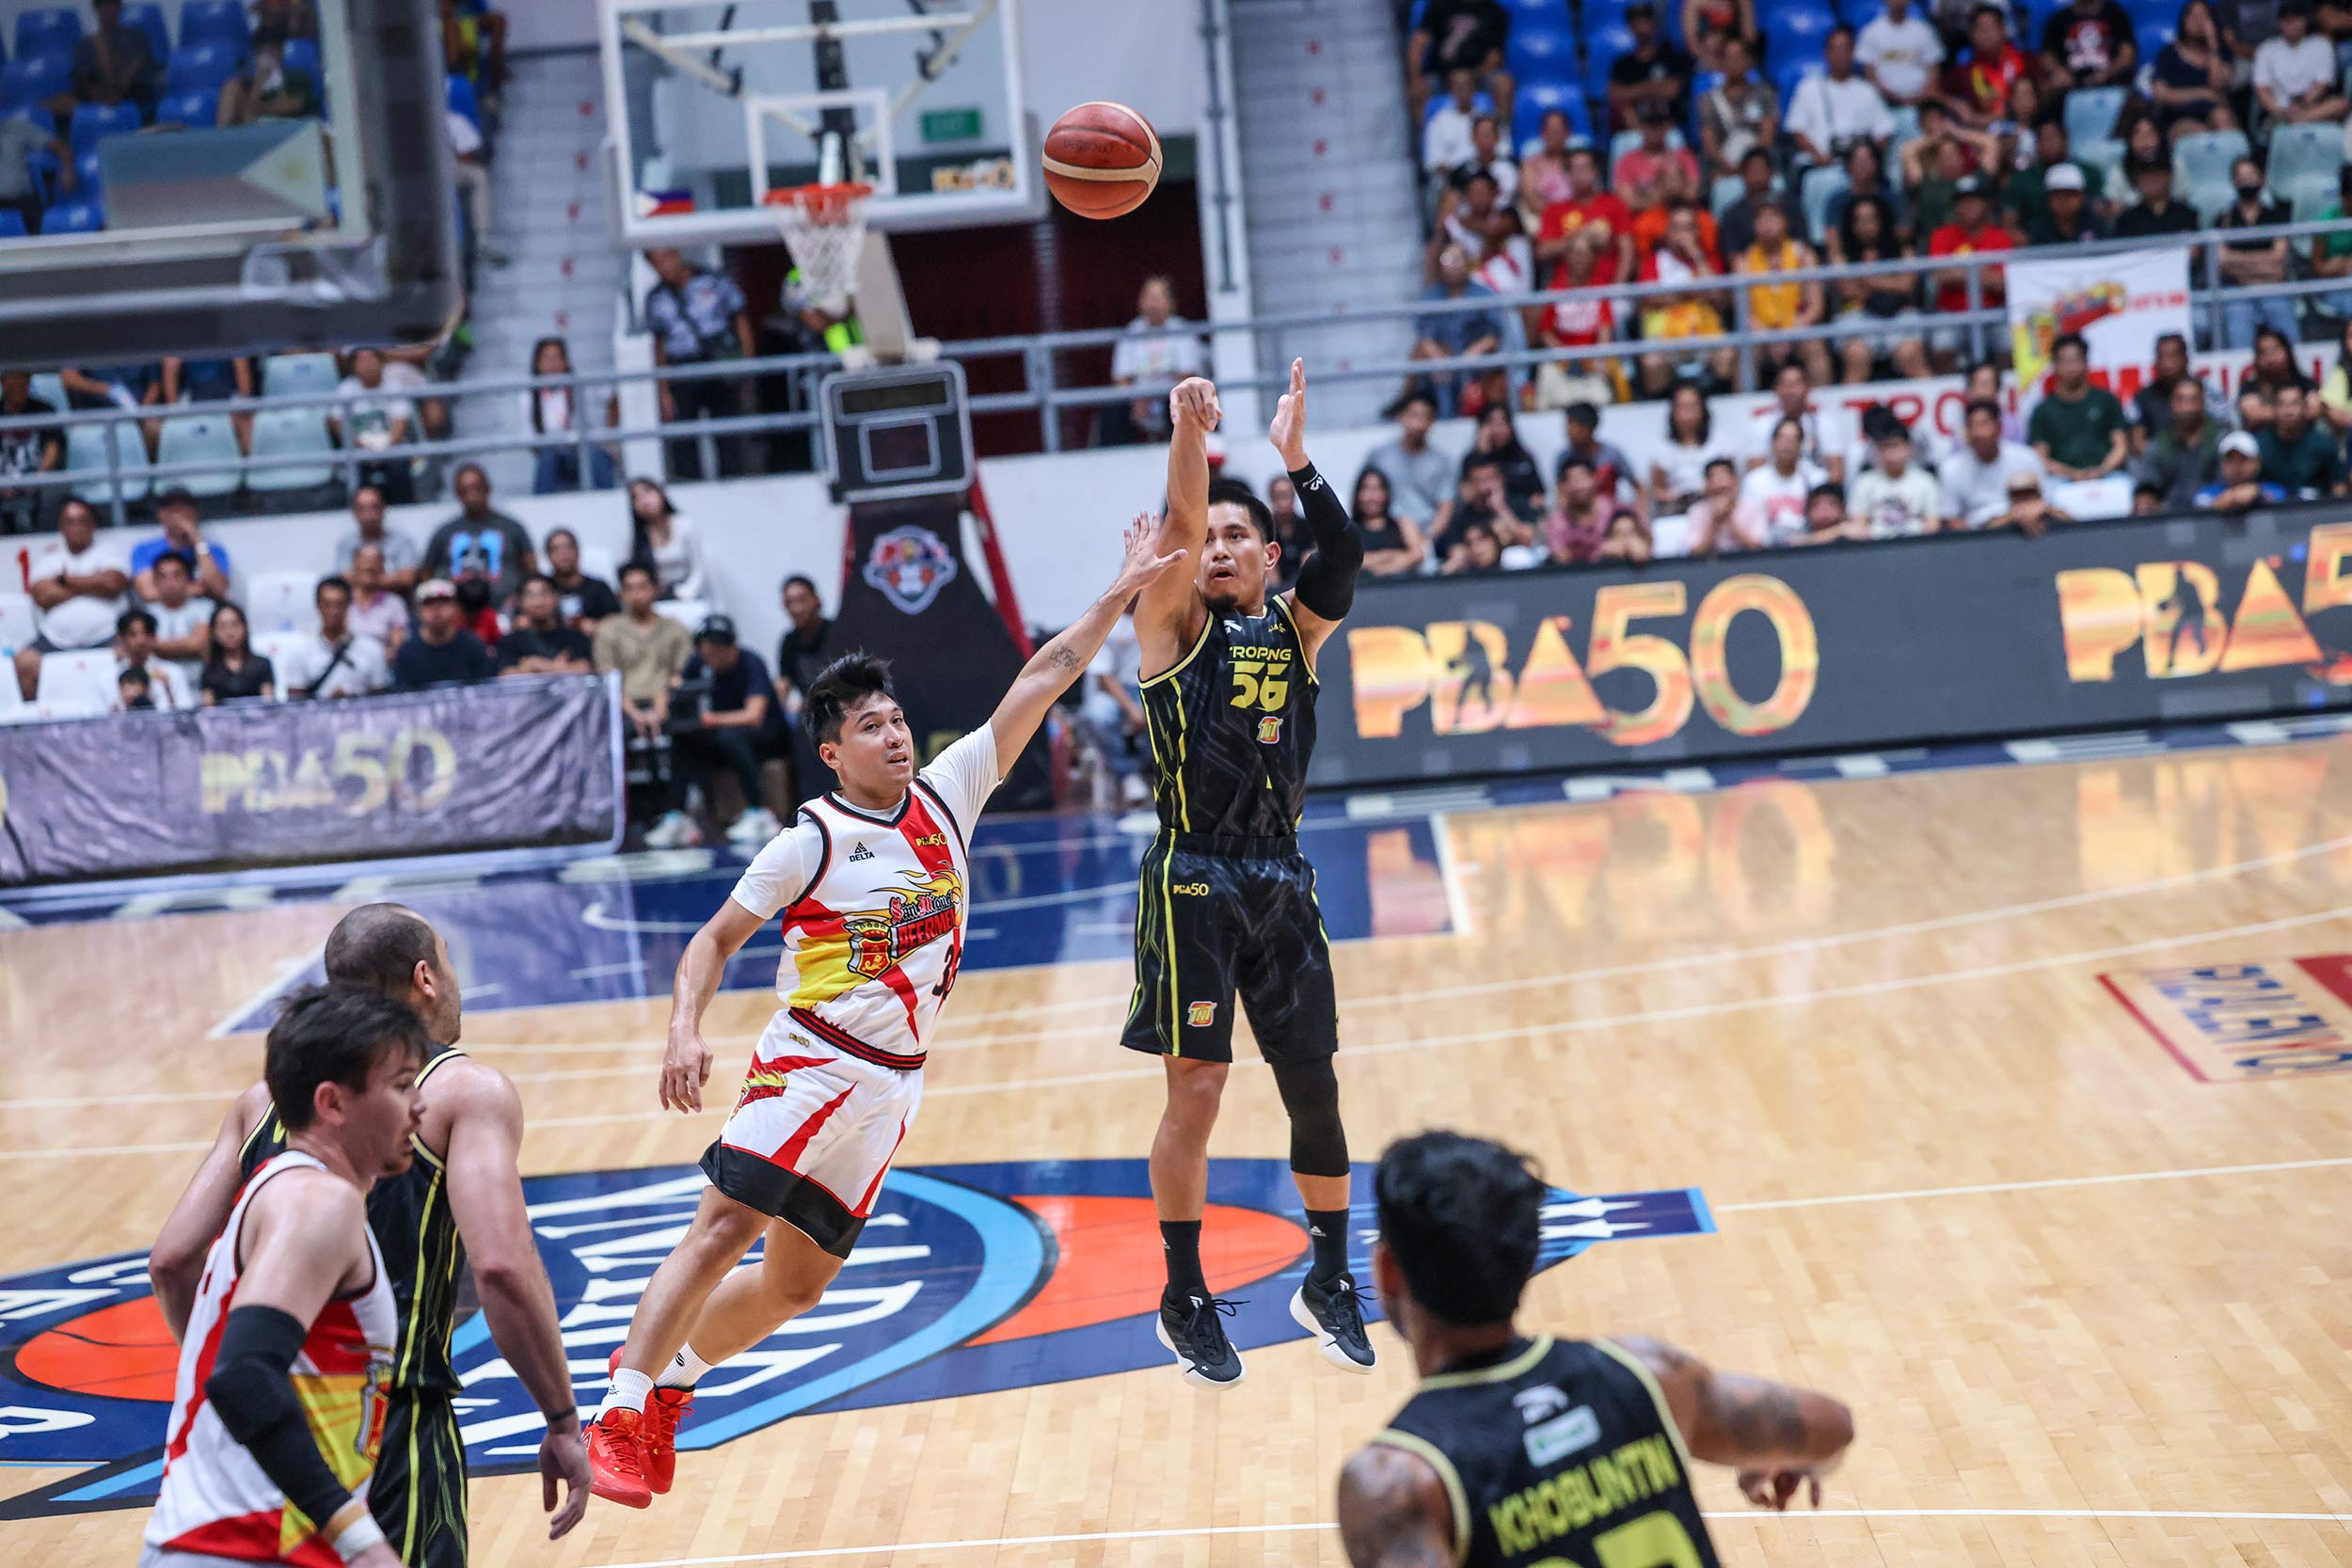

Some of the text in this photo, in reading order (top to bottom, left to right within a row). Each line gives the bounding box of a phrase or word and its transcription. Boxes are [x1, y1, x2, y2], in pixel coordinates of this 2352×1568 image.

[1227, 660, 1289, 712] 56
[849, 852, 875, 863] DELTA
[1189, 1003, 1215, 1023] TNT
[1487, 1432, 1680, 1559] KHOBUNTIN
